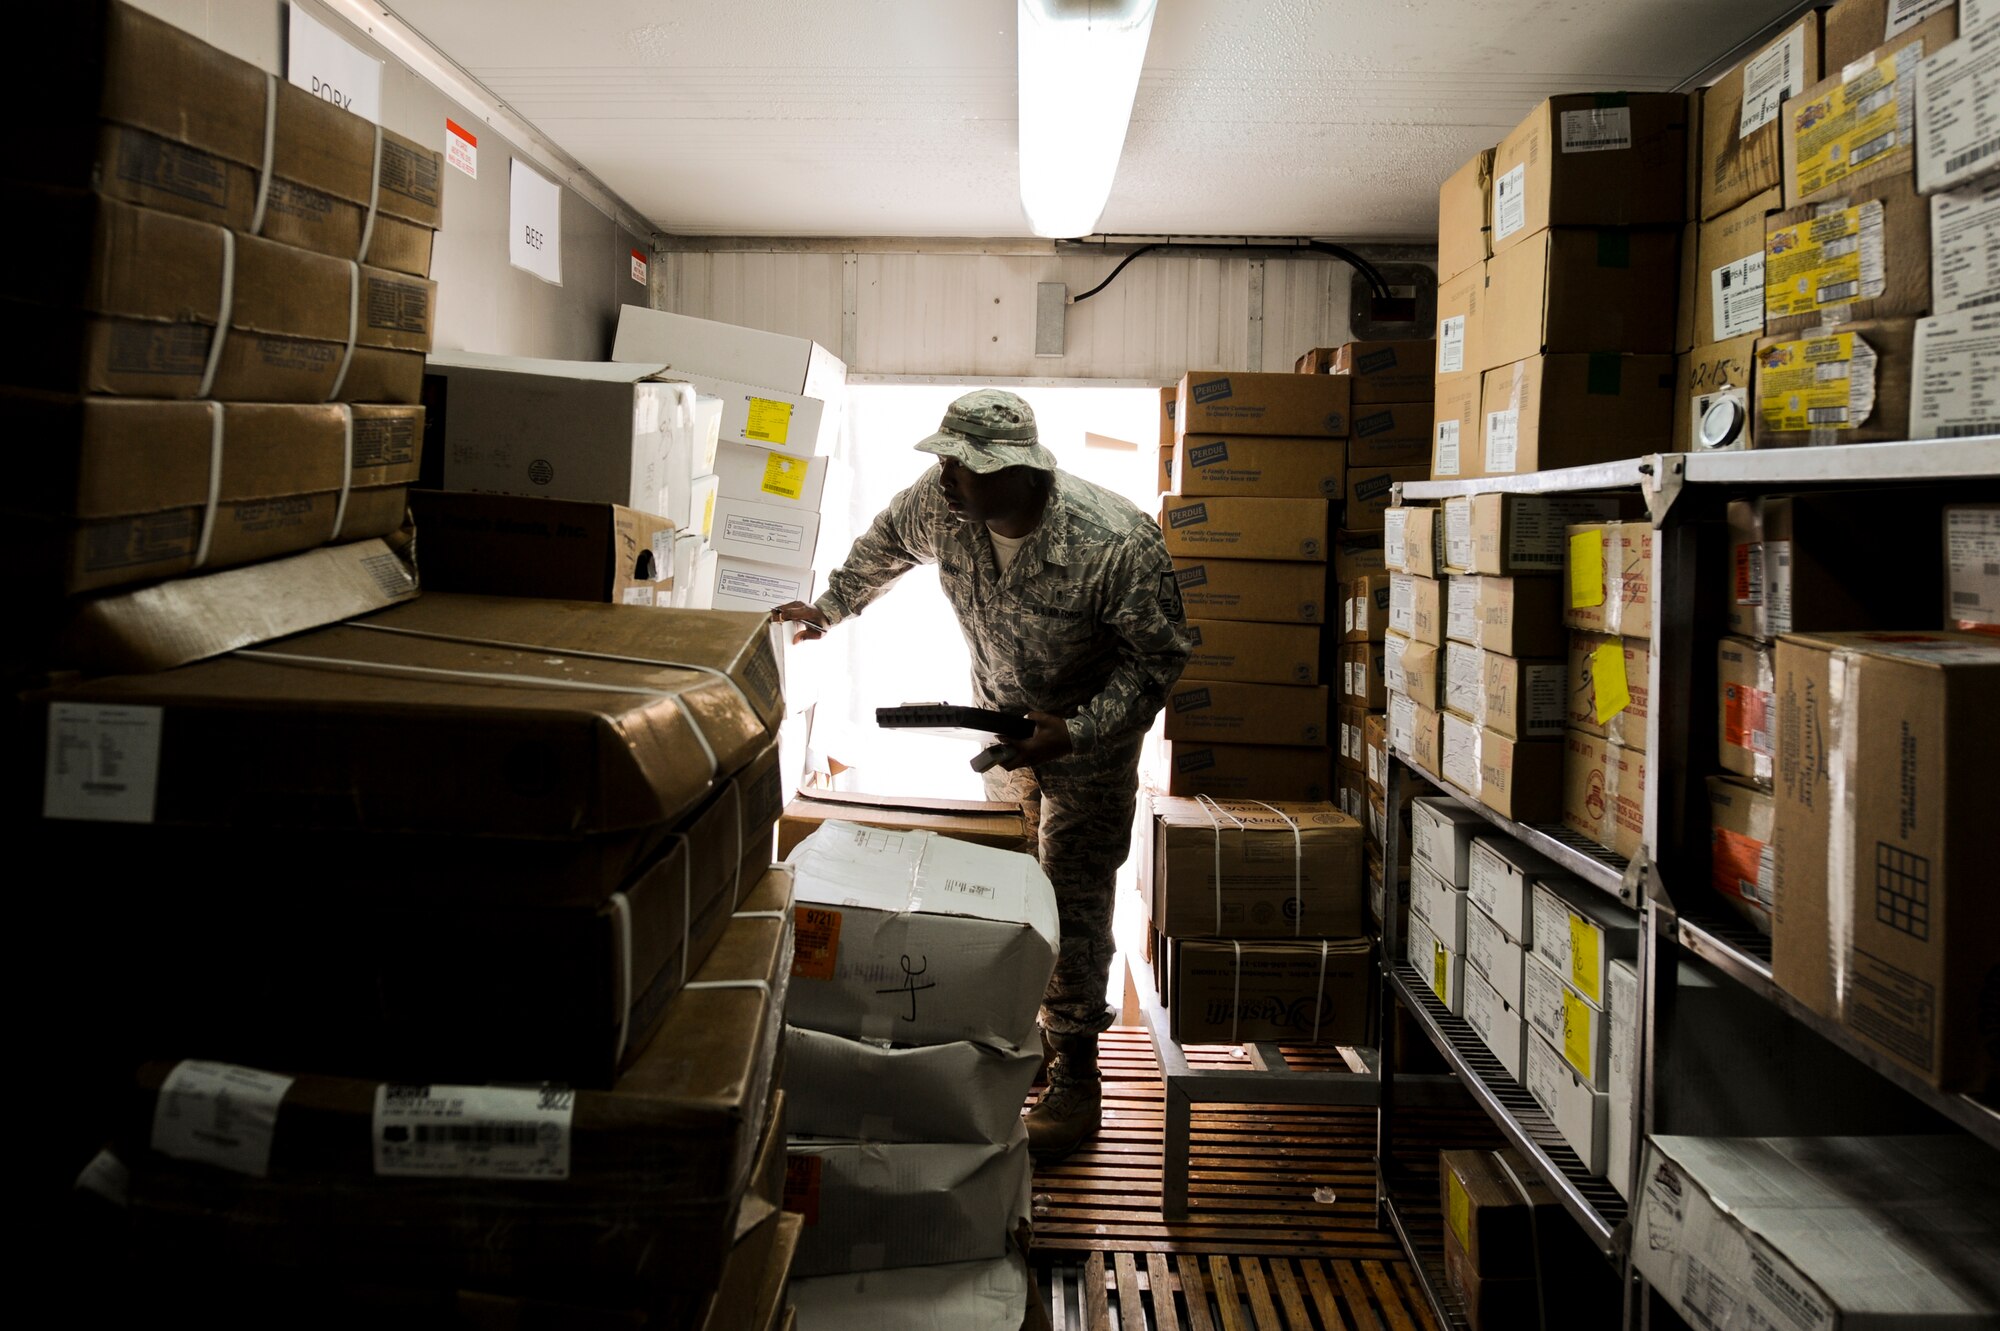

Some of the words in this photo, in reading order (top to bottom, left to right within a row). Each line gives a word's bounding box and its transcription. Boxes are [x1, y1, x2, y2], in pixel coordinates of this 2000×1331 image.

[312, 75, 352, 111] PORK
[1766, 99, 1779, 115] PISA
[289, 185, 332, 213] FROZEN
[526, 225, 543, 251] BEEF
[1730, 268, 1742, 281] PISA
[257, 336, 289, 358] KEEP
[291, 340, 337, 363] FROZEN
[1360, 351, 1392, 367] PERDUE
[1195, 382, 1229, 397] PERDUE
[1358, 414, 1390, 430] PERDUE
[1192, 445, 1225, 460] PERDUE
[1357, 476, 1391, 493] PERDUE
[234, 504, 266, 522] KEEP
[267, 497, 314, 517] FROZEN
[1171, 506, 1204, 521] PERDUE
[1061, 609, 1084, 619] FORCE
[1175, 690, 1208, 705] PERDUE
[1805, 678, 1816, 811] AdvancePierre
[1179, 751, 1212, 766] PERDUE
